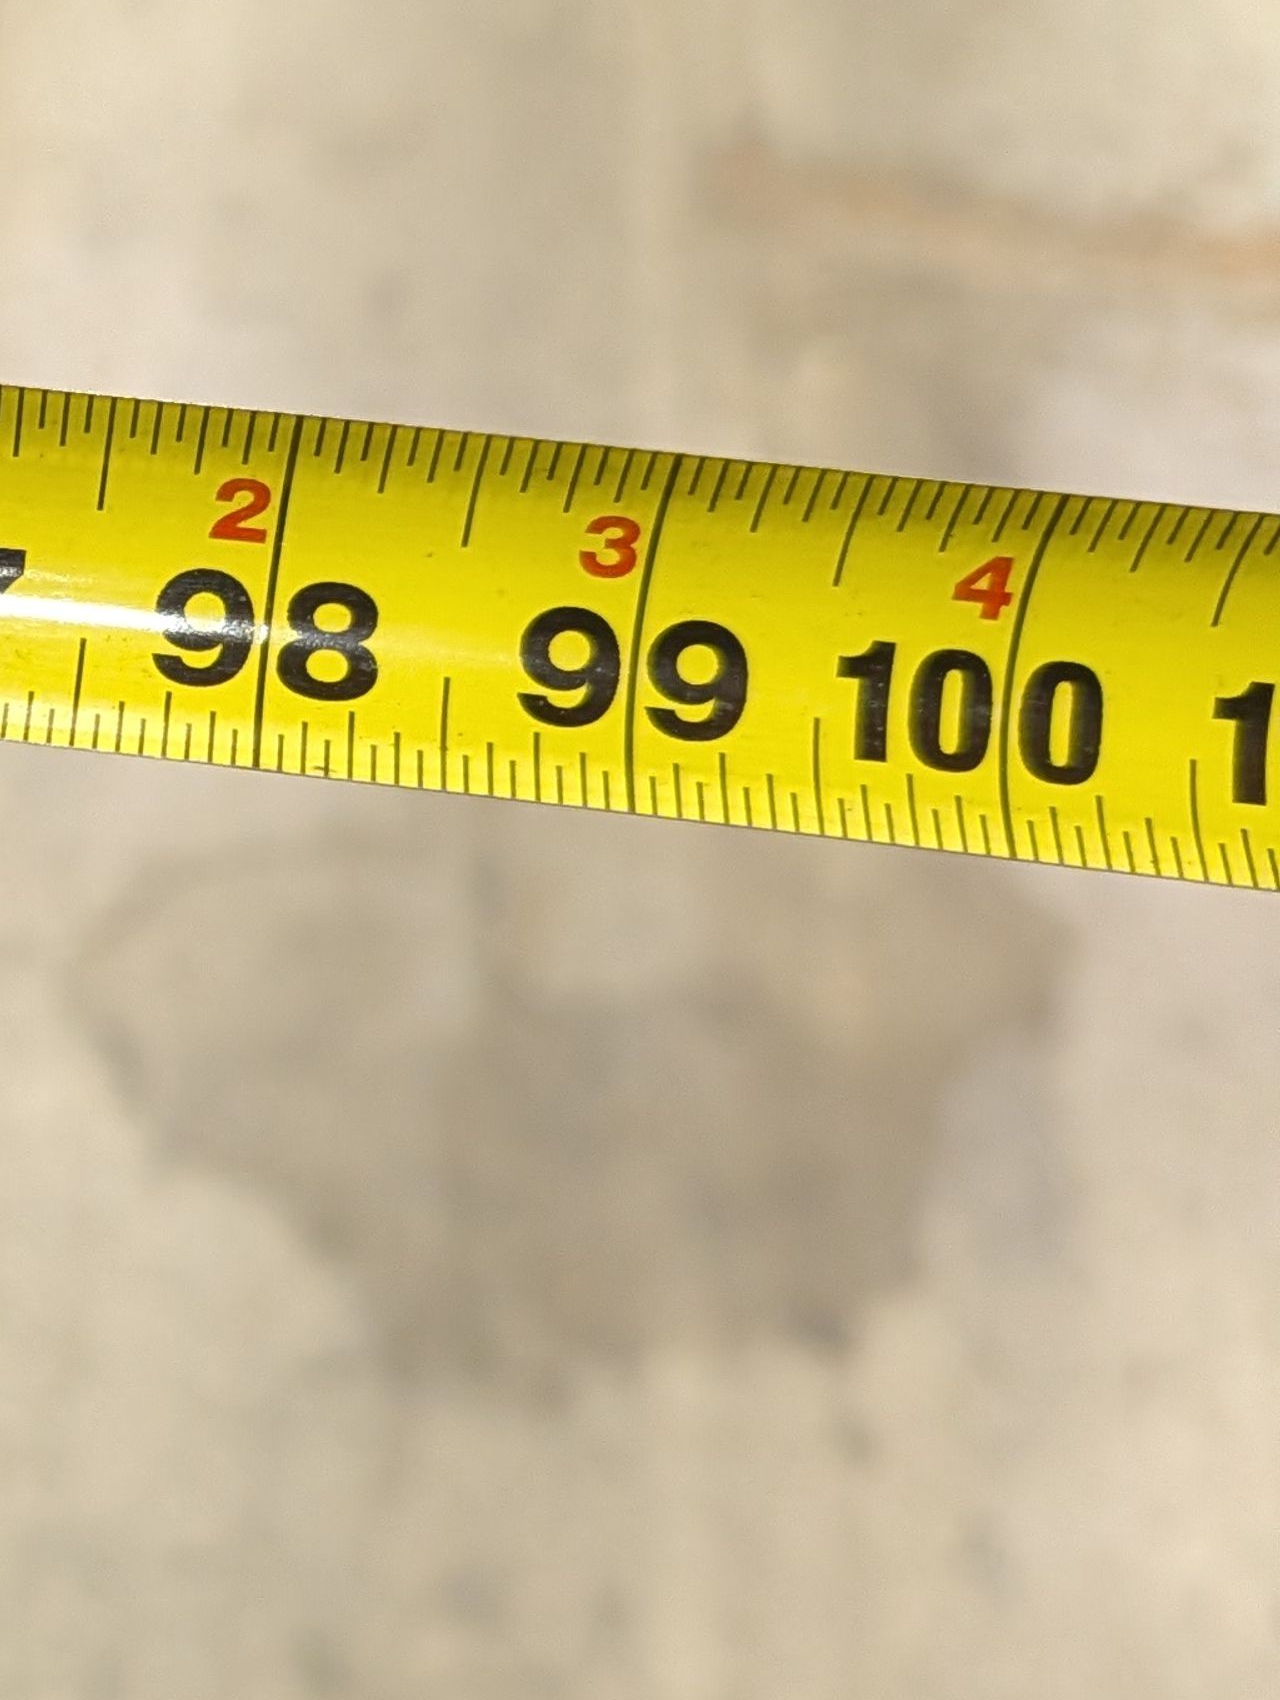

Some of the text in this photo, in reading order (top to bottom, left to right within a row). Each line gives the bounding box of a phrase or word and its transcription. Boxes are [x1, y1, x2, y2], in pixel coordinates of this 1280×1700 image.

[208, 478, 272, 544] 2
[579, 515, 641, 579] 3
[952, 556, 1014, 621] 4
[152, 568, 378, 702] 98
[517, 606, 749, 742] 99
[837, 640, 1105, 786] 100
